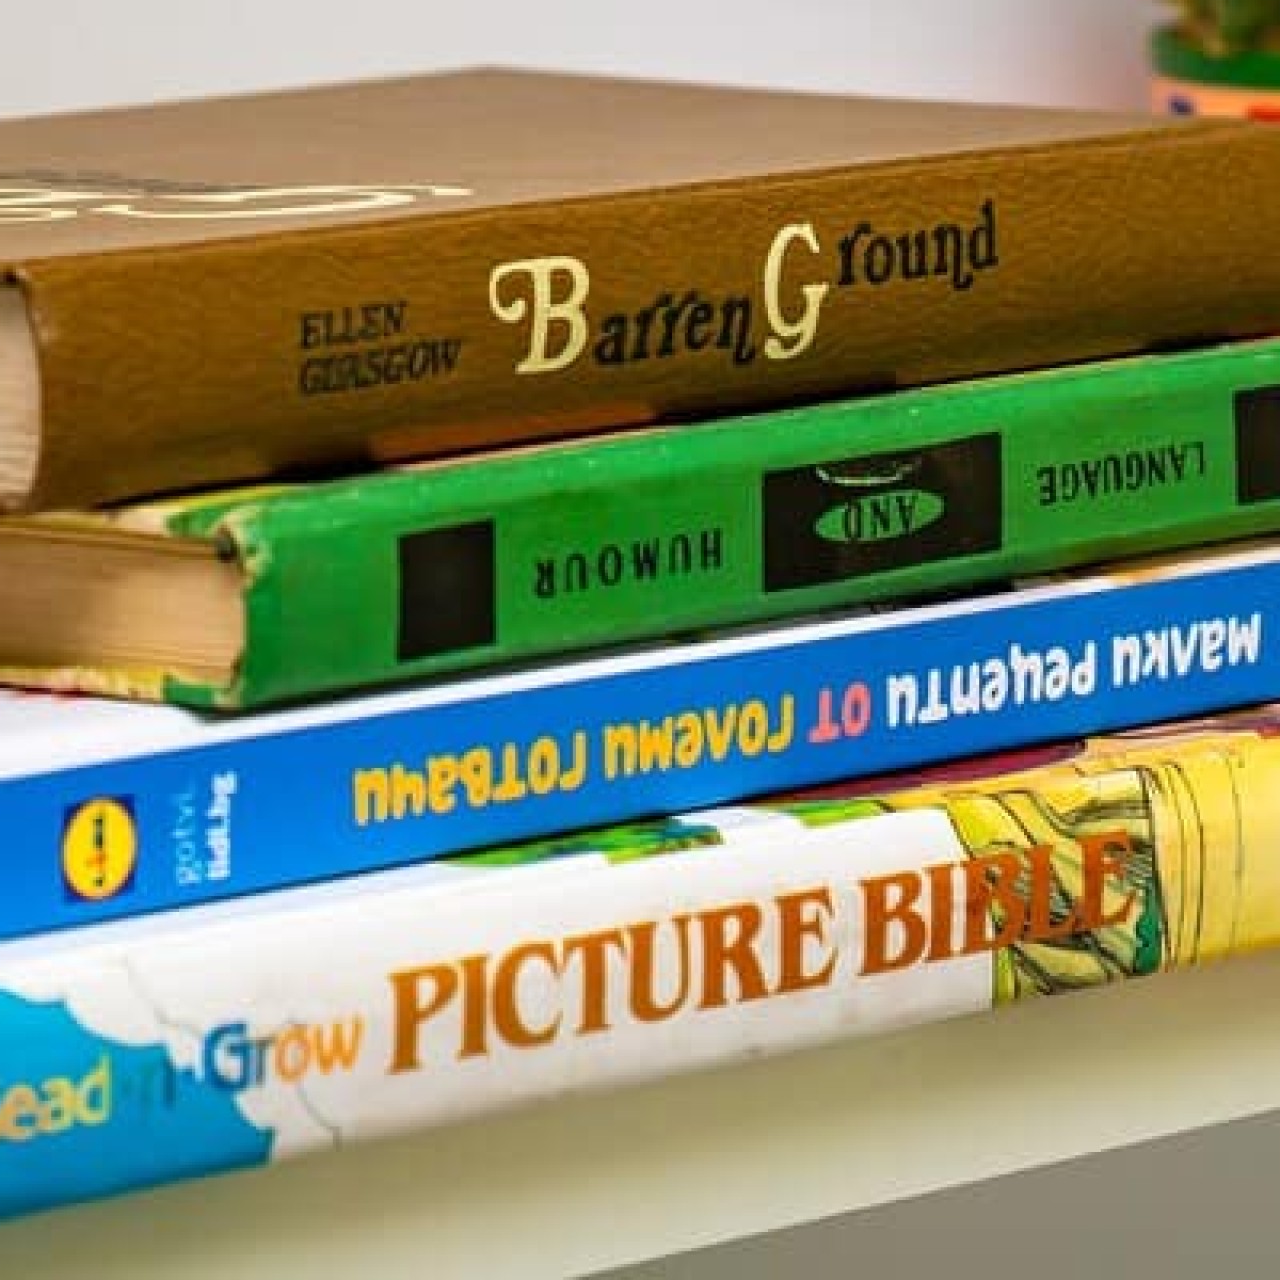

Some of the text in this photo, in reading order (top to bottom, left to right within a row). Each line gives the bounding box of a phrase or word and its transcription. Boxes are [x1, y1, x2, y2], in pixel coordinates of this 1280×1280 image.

[300, 300, 408, 349] ELLEN
[488, 199, 999, 375] Barren Ground
[298, 339, 462, 396] GLASGOW
[533, 440, 1207, 599] LANGUAGE AND HUMOUR
[203, 1012, 367, 1093] Grow
[388, 888, 841, 1075] PICTURE
[857, 829, 1137, 978] BIBLE
